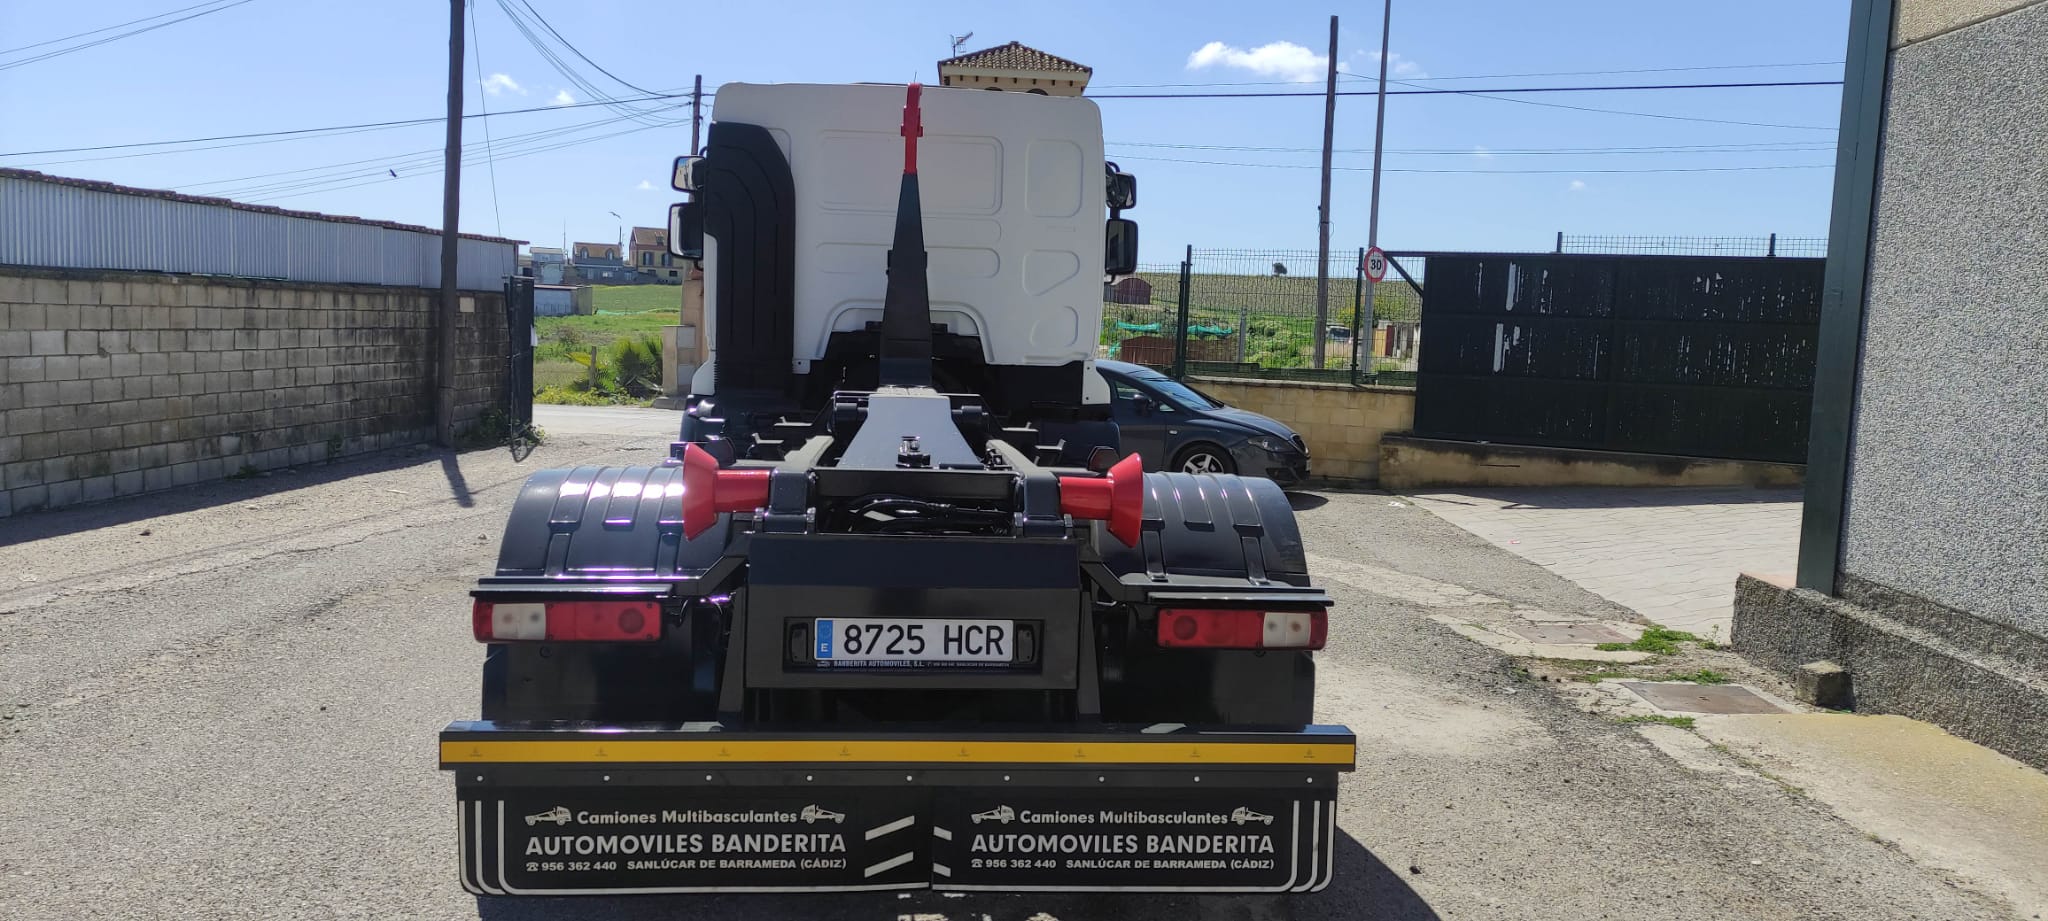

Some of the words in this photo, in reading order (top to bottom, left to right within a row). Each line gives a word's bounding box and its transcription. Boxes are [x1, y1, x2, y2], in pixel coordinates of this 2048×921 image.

[1370, 259, 1382, 270] 30
[843, 624, 925, 656] 8725
[943, 625, 1005, 656] HCR
[821, 643, 829, 652] E
[577, 811, 656, 824] Camiones
[663, 810, 796, 823] Multibasculantes
[1020, 810, 1094, 823] Camiones
[1100, 811, 1227, 824] Multibasculantes
[526, 834, 702, 855] AUTOMOVILES
[712, 834, 845, 852] BANDERITA
[972, 835, 1137, 853] AUTOMOVILES
[1147, 835, 1274, 853] BANDERITA
[542, 862, 564, 871] 956
[568, 862, 590, 870] 362
[593, 862, 616, 870] 440
[628, 858, 696, 869] SANLÚCAR
[700, 860, 715, 868] DE
[720, 860, 796, 868] BARRAMEDA
[801, 858, 846, 869] (CÁDIZ)
[1035, 860, 1056, 868] 440
[1067, 858, 1130, 868] SANLÚCAR
[1135, 860, 1150, 868] DE
[1154, 860, 1226, 868] BARRAMEDA
[1231, 859, 1274, 869] (CÁDIZ)
